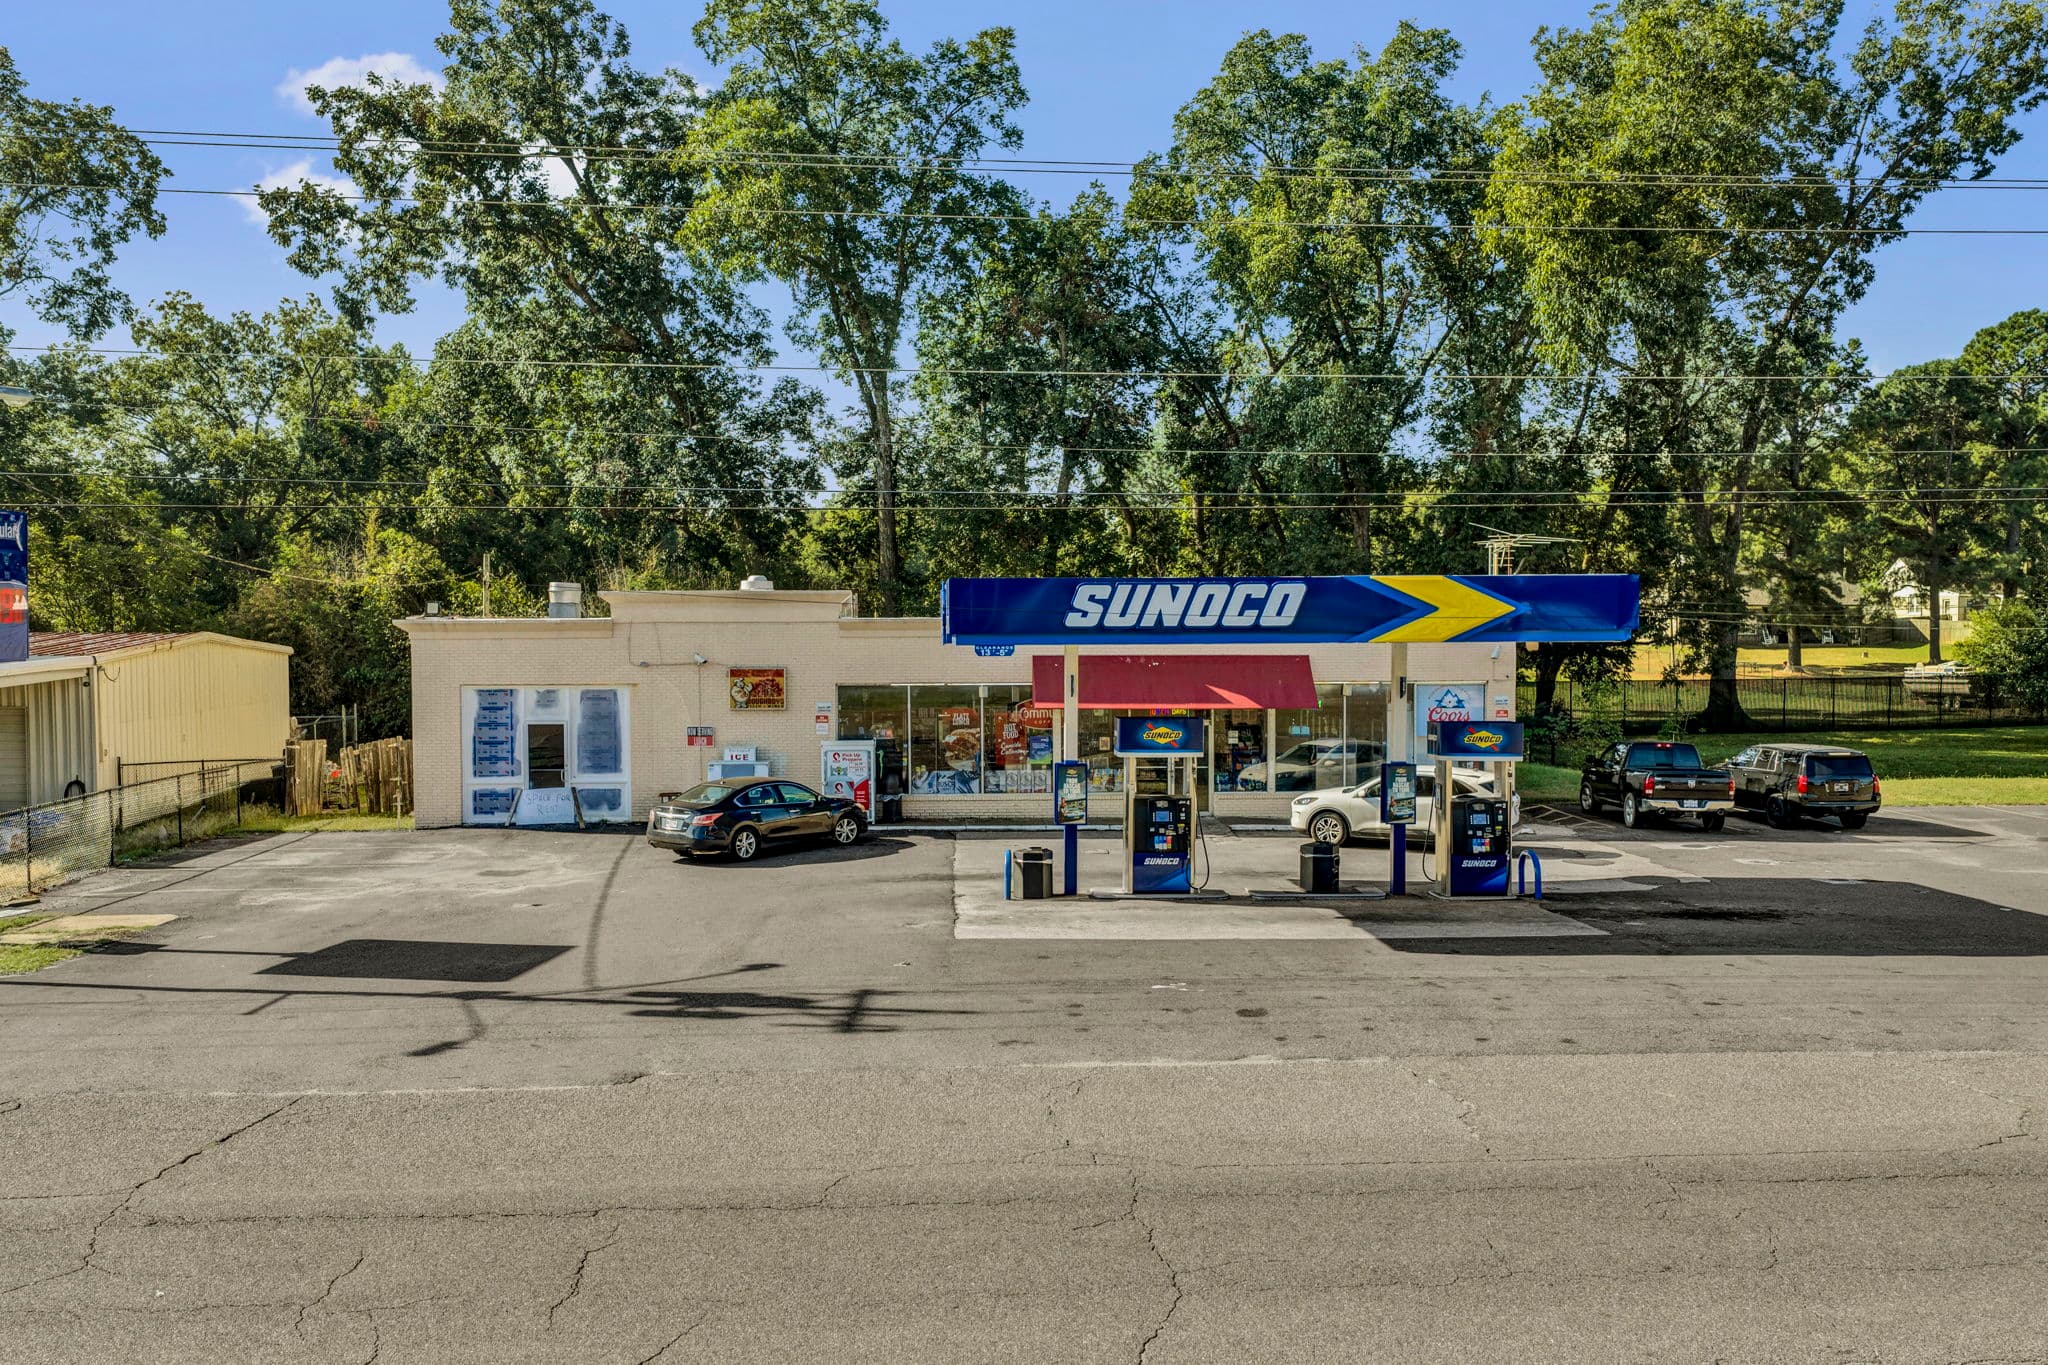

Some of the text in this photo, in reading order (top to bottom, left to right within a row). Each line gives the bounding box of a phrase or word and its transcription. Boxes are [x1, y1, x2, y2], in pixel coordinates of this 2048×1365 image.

[1064, 583, 1307, 628] SUNOCO
[1429, 707, 1471, 722] Coors
[1003, 731, 1019, 740] FOOD
[1144, 731, 1181, 740] SUNOCO
[1466, 734, 1502, 743] SUNOCO
[730, 753, 749, 761] ICE
[1144, 857, 1180, 866] SUNOCO
[1461, 859, 1498, 868] SUNOCO
